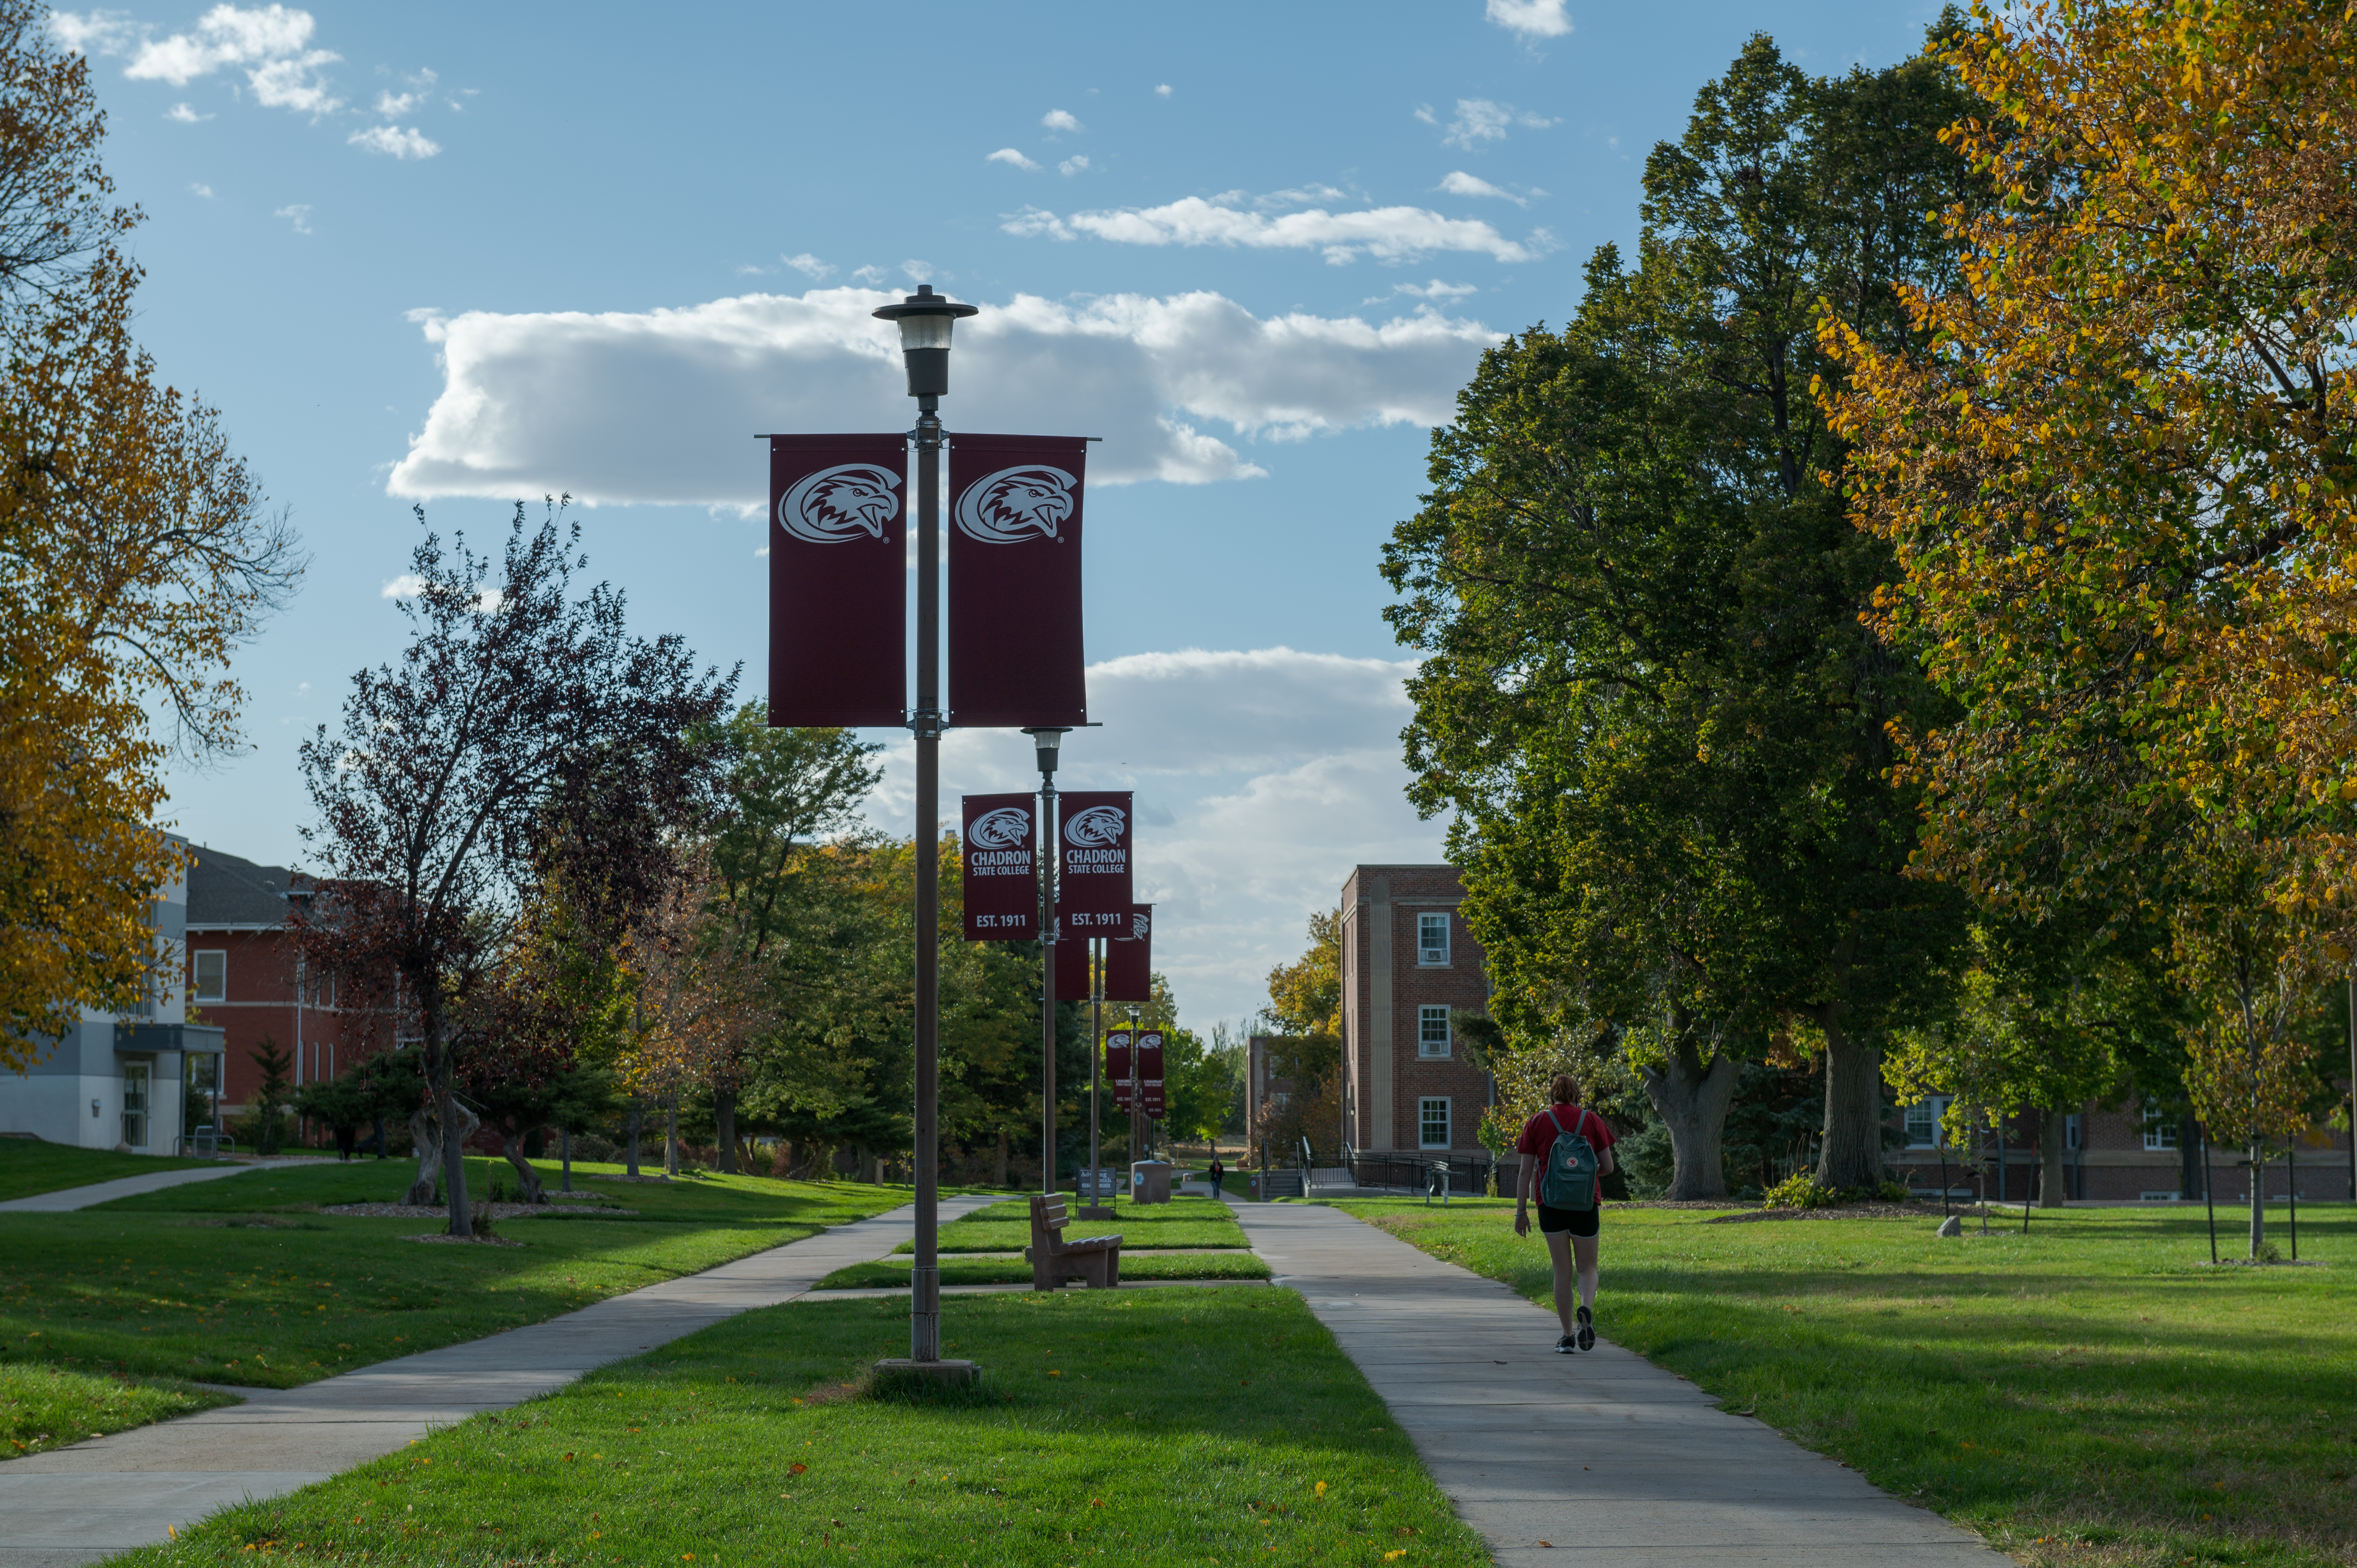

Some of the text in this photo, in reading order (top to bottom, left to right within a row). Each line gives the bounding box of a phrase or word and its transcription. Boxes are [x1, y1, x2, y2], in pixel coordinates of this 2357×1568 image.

[971, 850, 1030, 866] CHADRON
[1066, 849, 1125, 863] CHADRON
[973, 865, 1029, 876] STATE COLLEGE
[1069, 864, 1124, 874] STATE COLLEGE
[977, 915, 1025, 927] EST. 1911
[1072, 913, 1120, 925] EST. 1911
